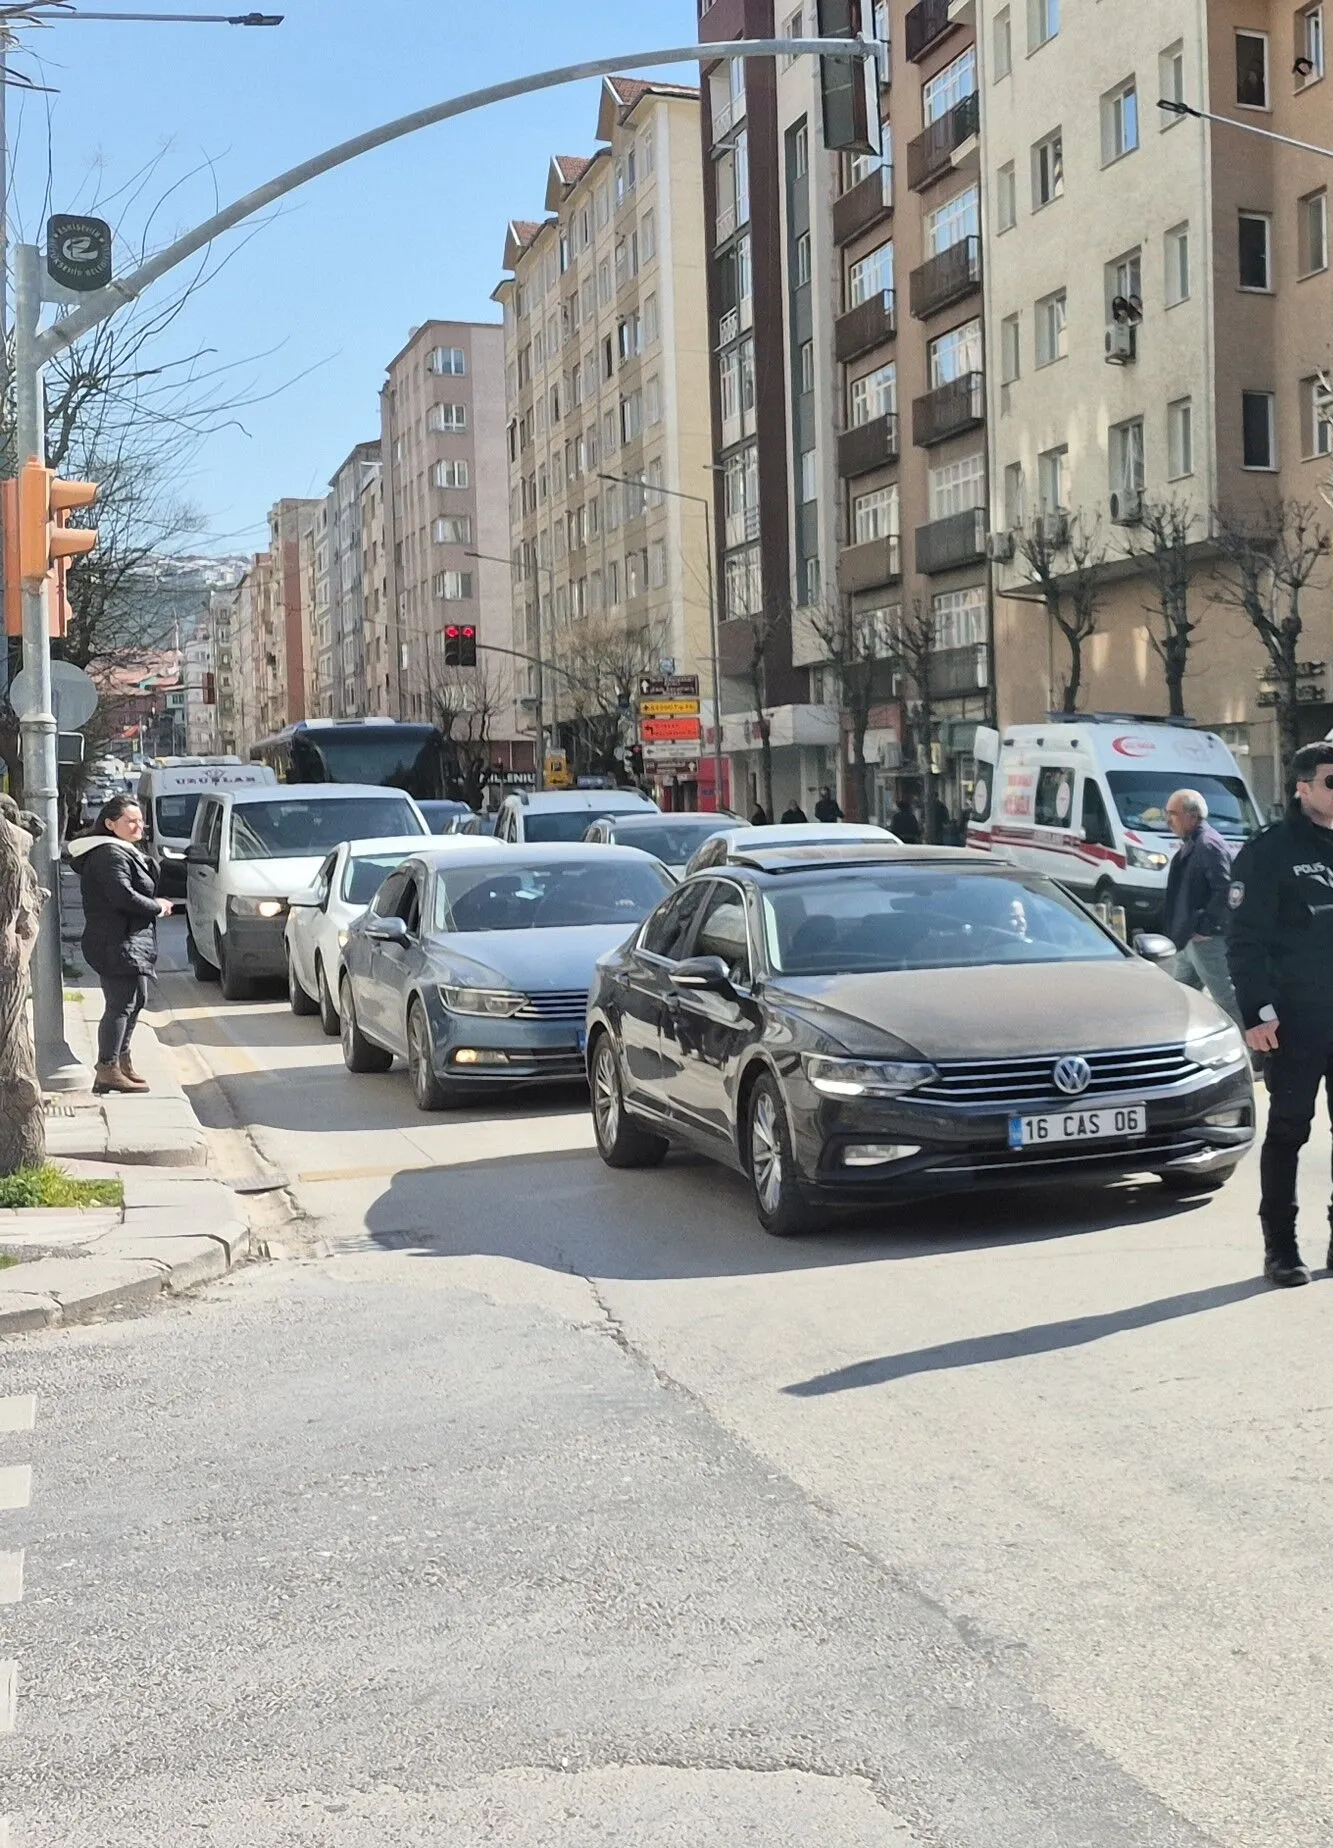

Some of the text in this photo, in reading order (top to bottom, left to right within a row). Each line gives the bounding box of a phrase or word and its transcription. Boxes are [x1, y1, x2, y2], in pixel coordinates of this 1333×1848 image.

[1025, 1109, 1138, 1140] 16 CAS 06
